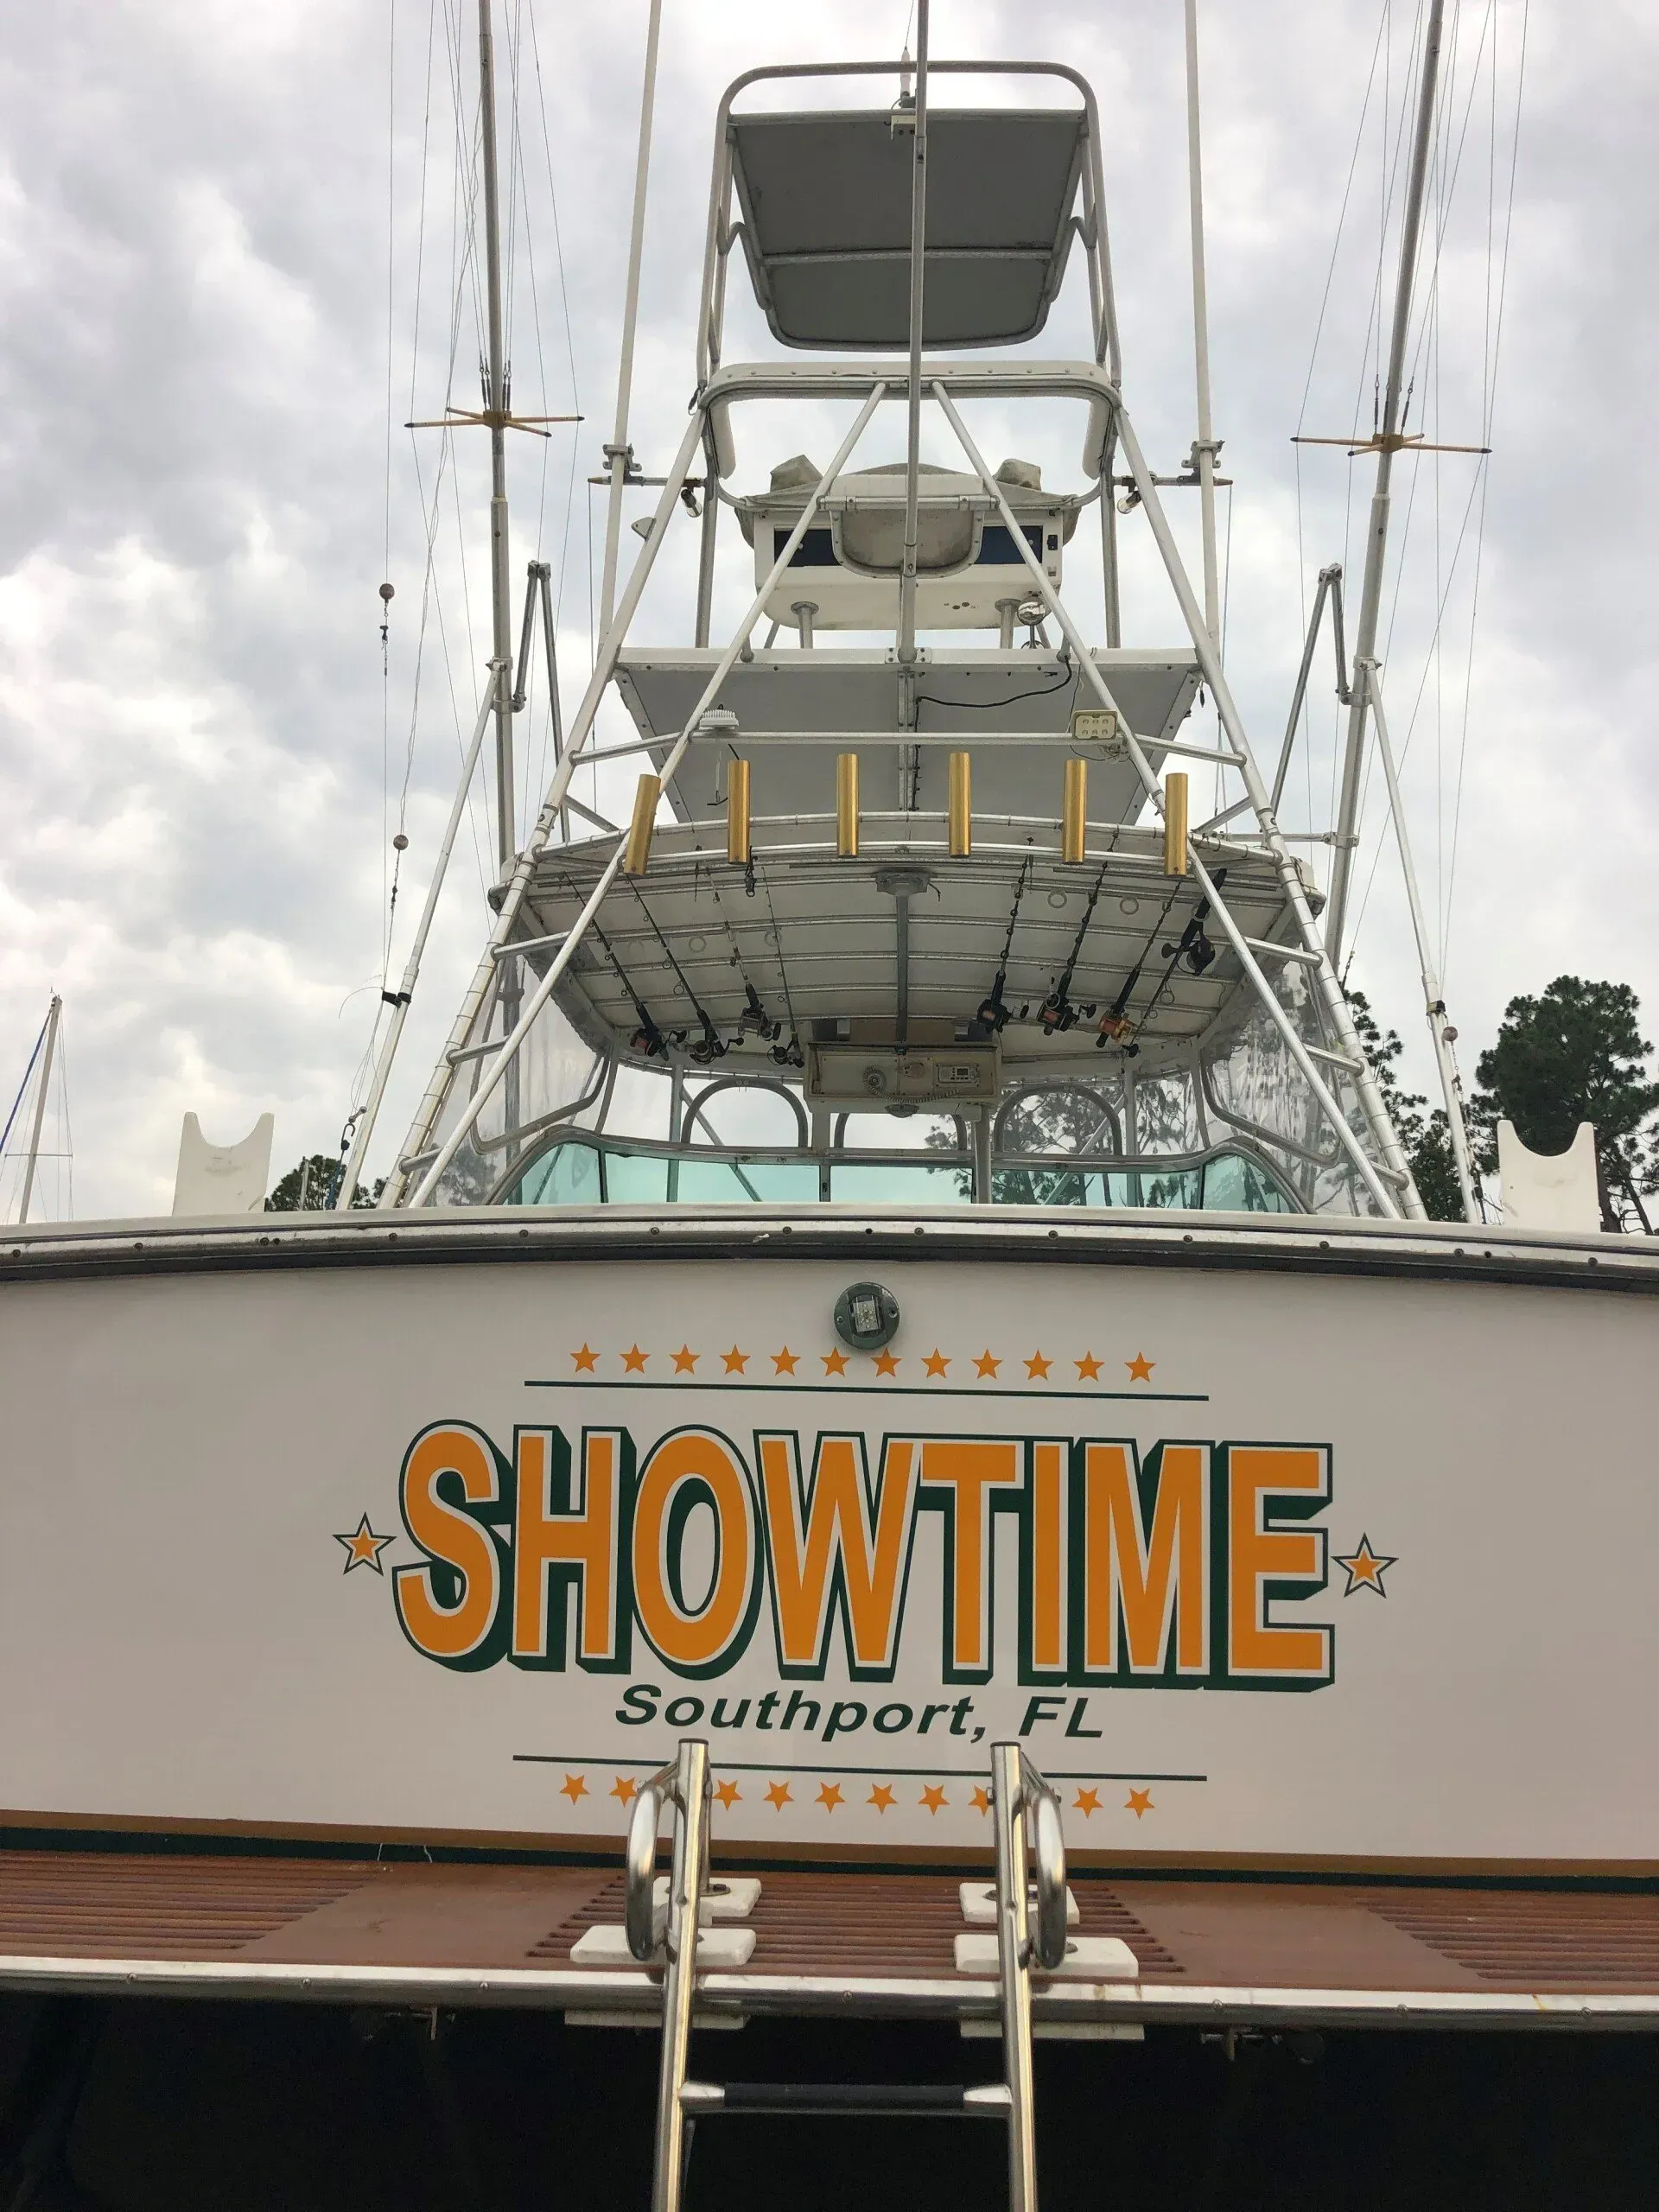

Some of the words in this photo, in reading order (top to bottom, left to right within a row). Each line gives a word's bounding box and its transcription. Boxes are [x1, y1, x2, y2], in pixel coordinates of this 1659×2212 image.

[393, 1420, 1335, 1692] SHOWTIME
[615, 1684, 986, 1743] Southport,
[1019, 1696, 1104, 1738] FL
